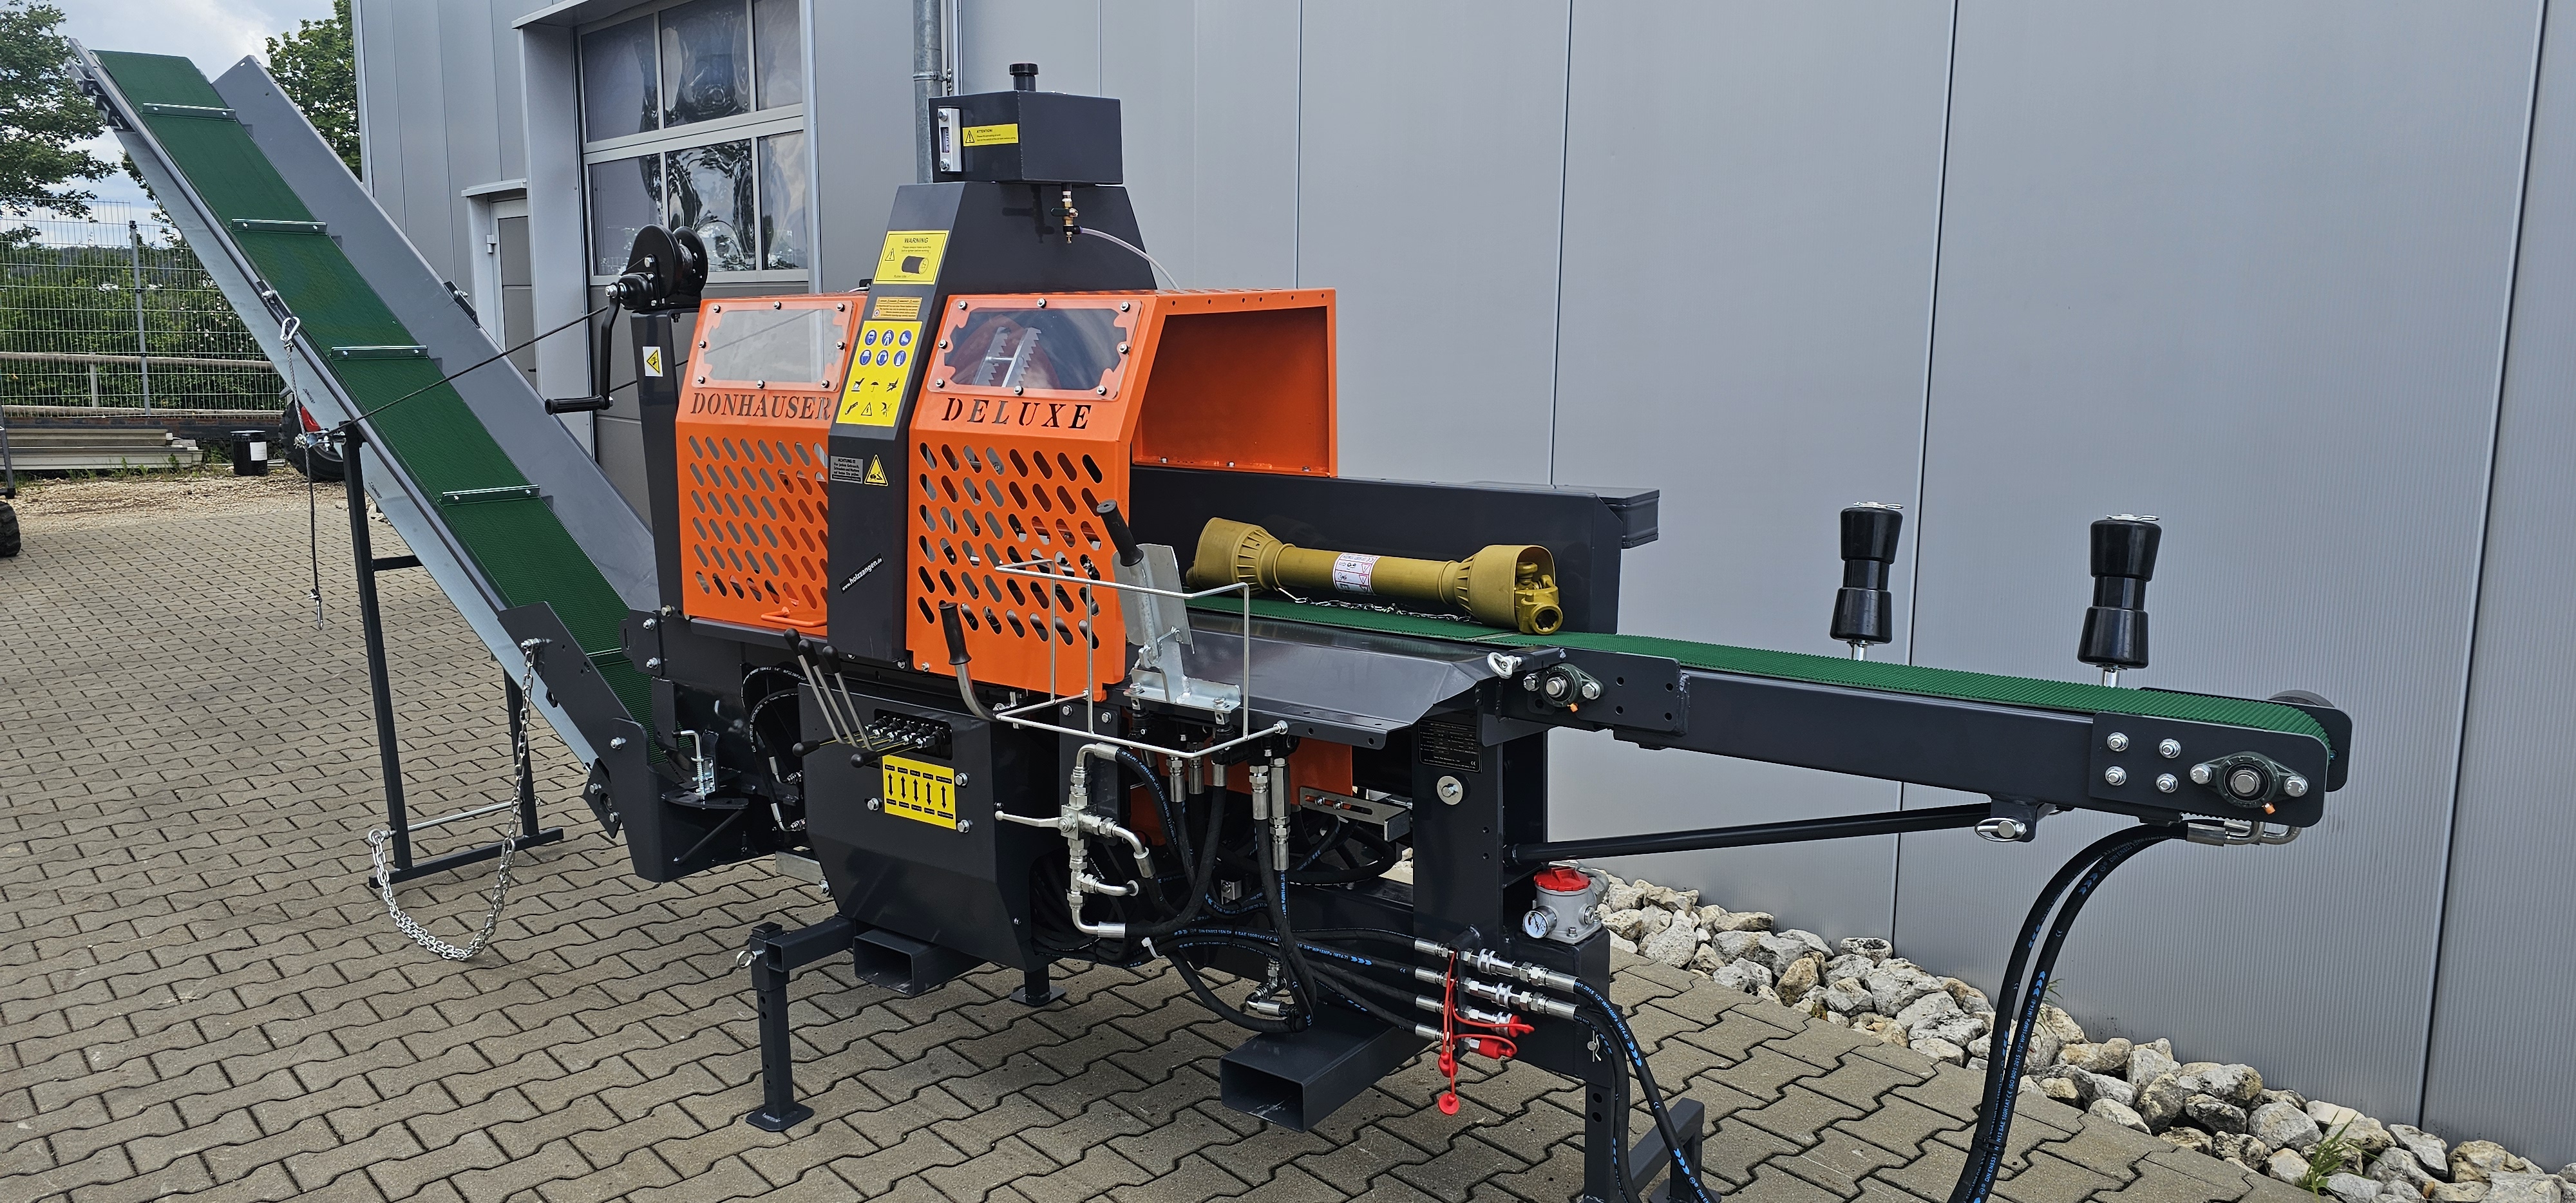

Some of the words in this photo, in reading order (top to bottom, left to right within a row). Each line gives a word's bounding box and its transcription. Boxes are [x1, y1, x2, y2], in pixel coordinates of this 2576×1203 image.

[690, 392, 831, 421] DONHAUSER
[941, 397, 1092, 430] DELUXE
[842, 558, 882, 591] www.holzzangen.de
[1988, 1156, 1996, 1171] EN853
[2002, 1099, 2011, 1121] 100R1AT
[2010, 1054, 2021, 1079] 9001:2015
[2020, 1018, 2031, 1043] WP16MPa
[1696, 1189, 1705, 1199] DIN
